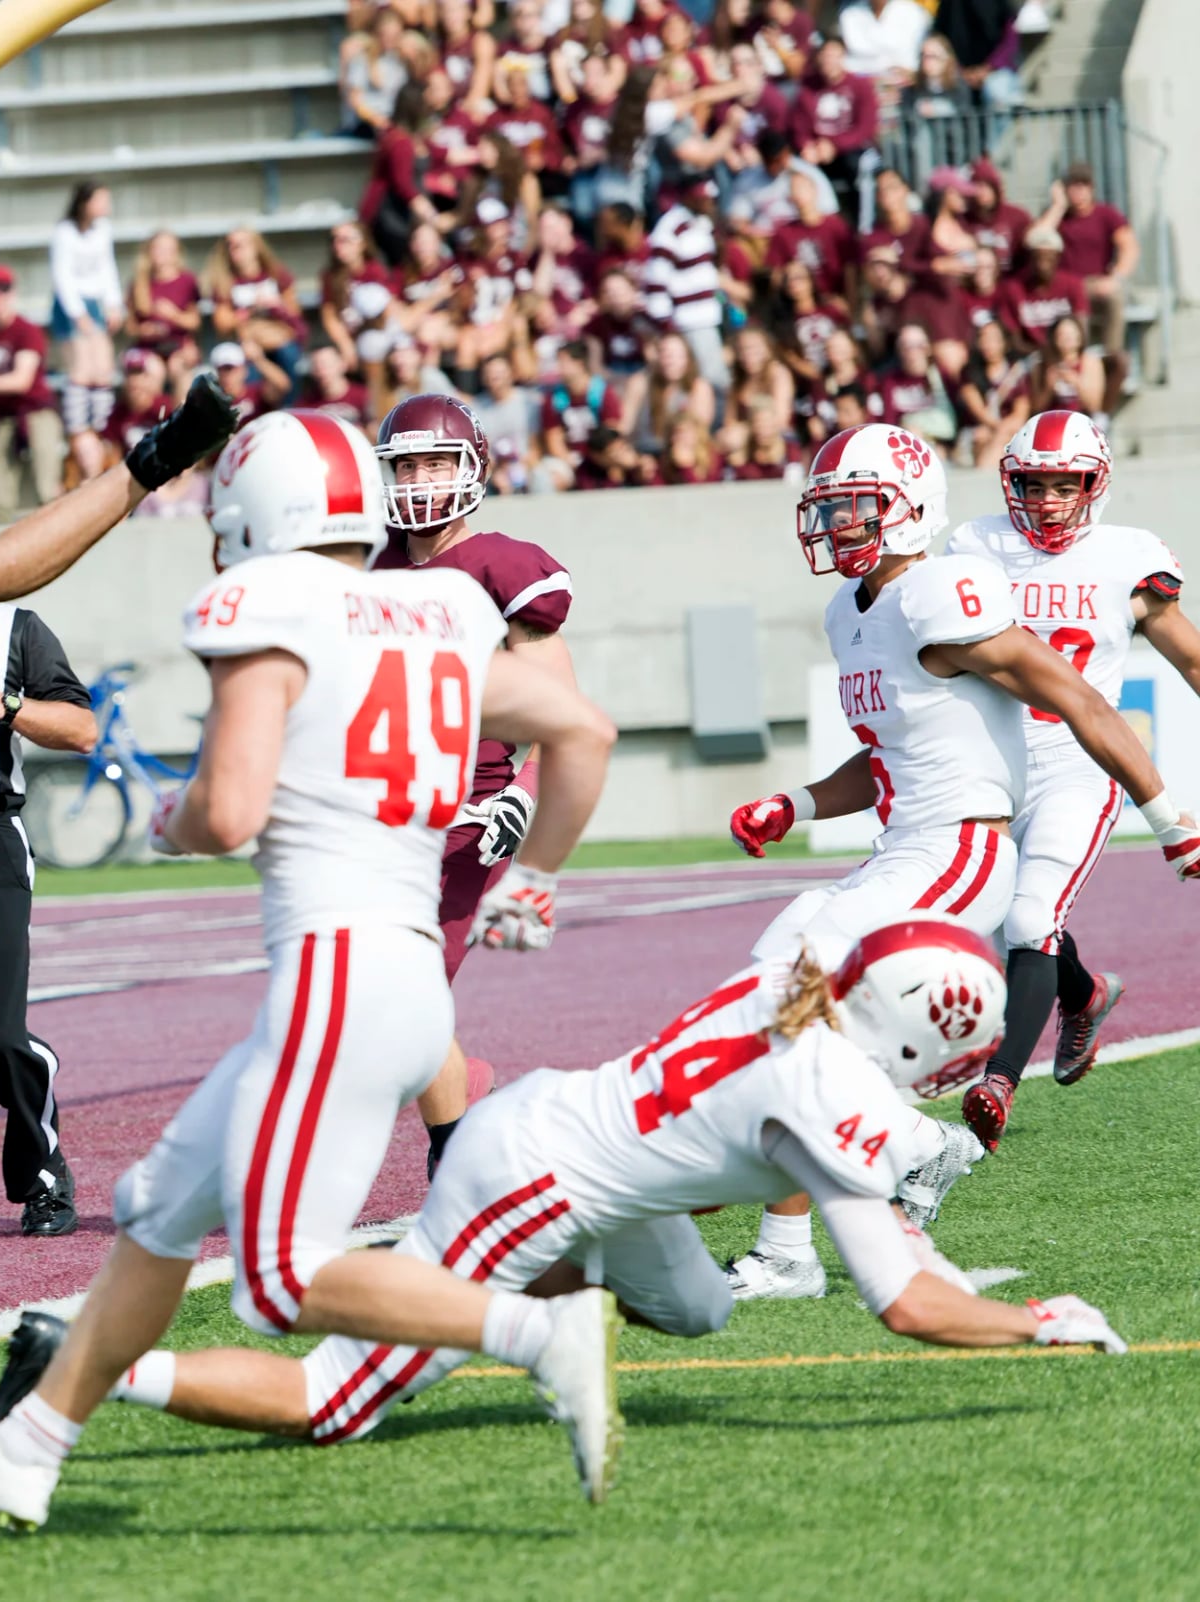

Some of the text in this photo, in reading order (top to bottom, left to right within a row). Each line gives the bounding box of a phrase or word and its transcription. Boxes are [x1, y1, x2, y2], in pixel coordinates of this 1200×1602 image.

[196, 585, 246, 627] 49
[955, 577, 983, 618] 6
[344, 649, 472, 830] 49
[834, 1112, 890, 1168] 44
